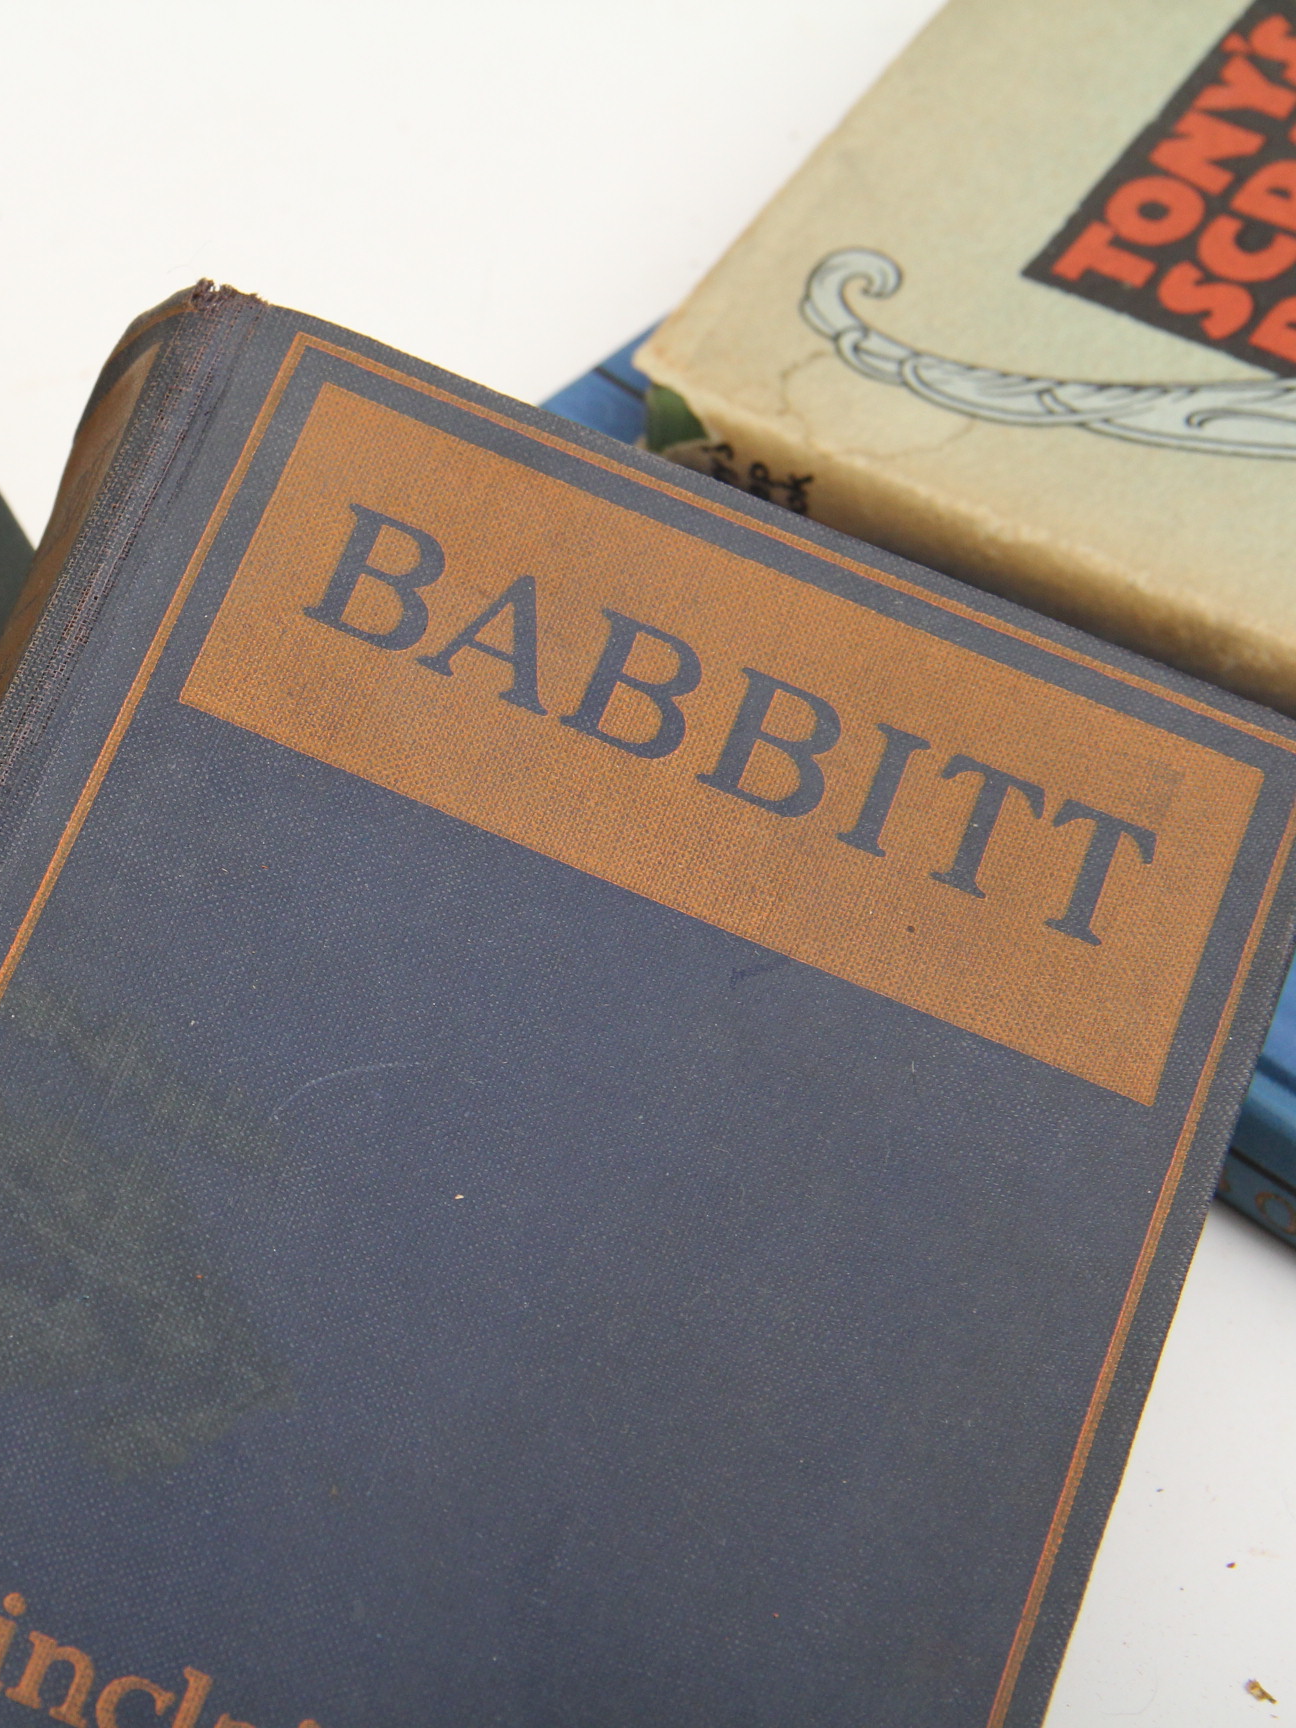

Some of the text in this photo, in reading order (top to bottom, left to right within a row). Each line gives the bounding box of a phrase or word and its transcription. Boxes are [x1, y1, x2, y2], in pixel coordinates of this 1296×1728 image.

[1050, 13, 1296, 289] TONY'S
[1156, 124, 1296, 341] SC
[303, 503, 1158, 946] BABBITT
